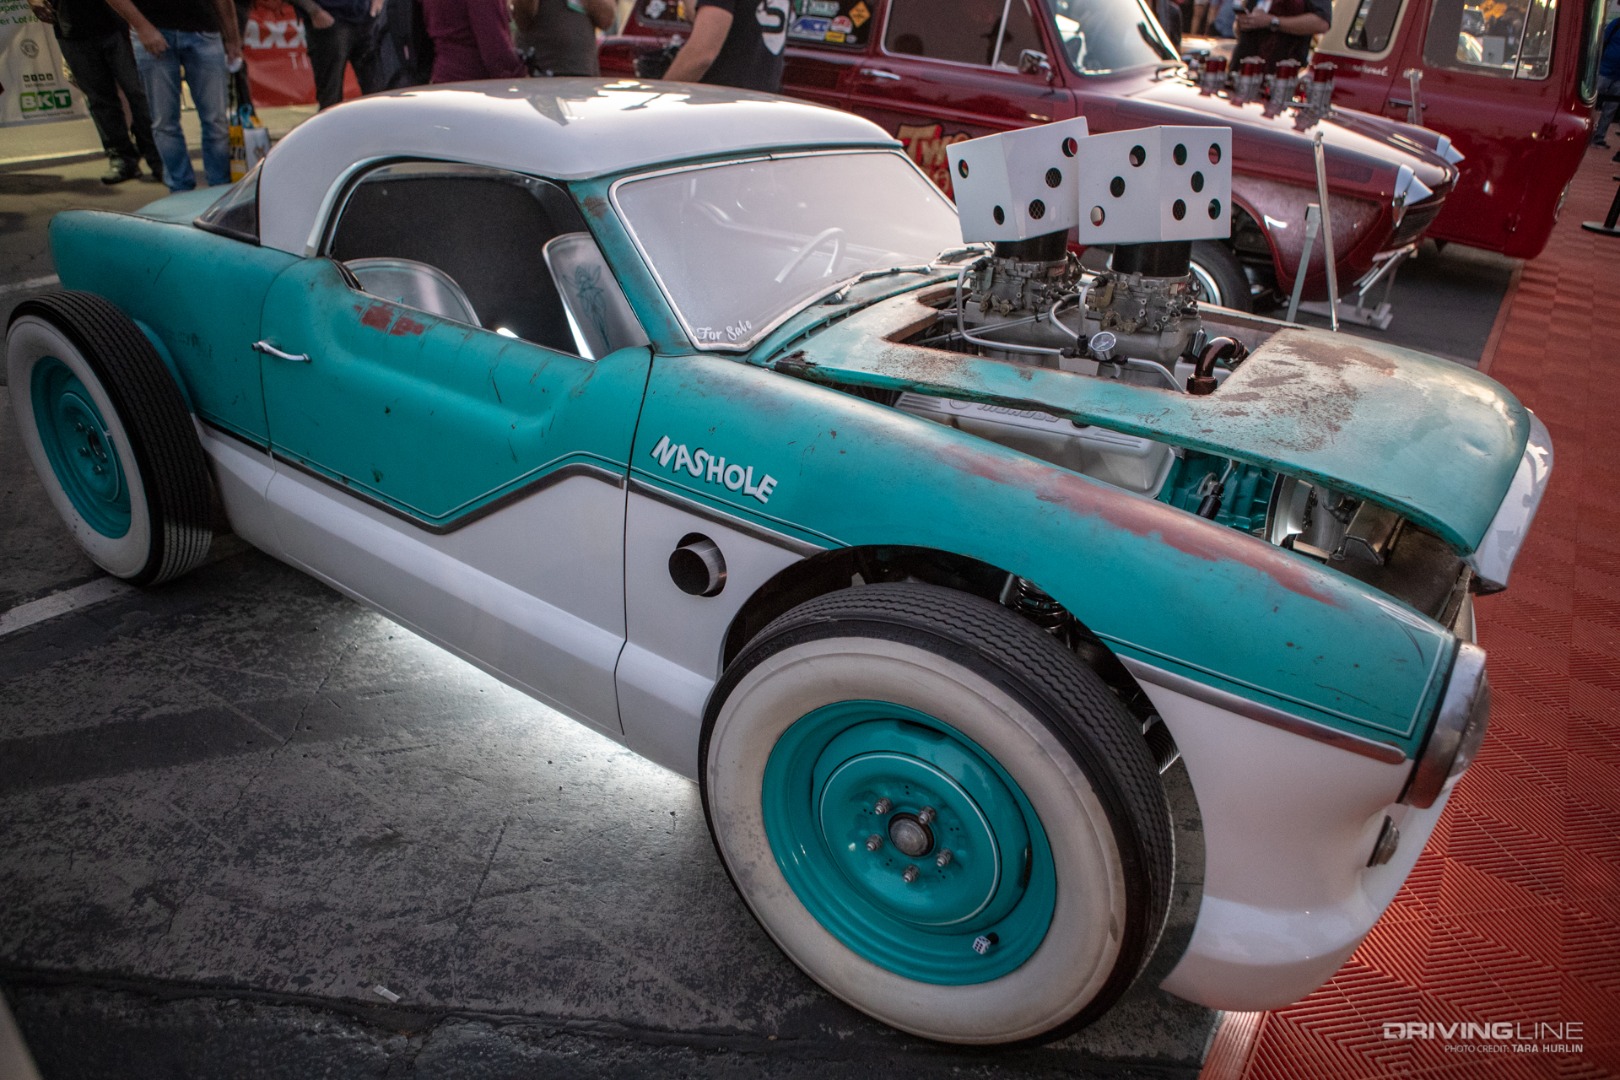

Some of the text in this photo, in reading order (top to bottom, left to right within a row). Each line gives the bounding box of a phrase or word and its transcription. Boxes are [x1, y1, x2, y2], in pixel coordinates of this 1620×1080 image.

[21, 91, 70, 109] BKT
[696, 319, 752, 341] For Sale
[650, 434, 778, 504] NASHOLE
